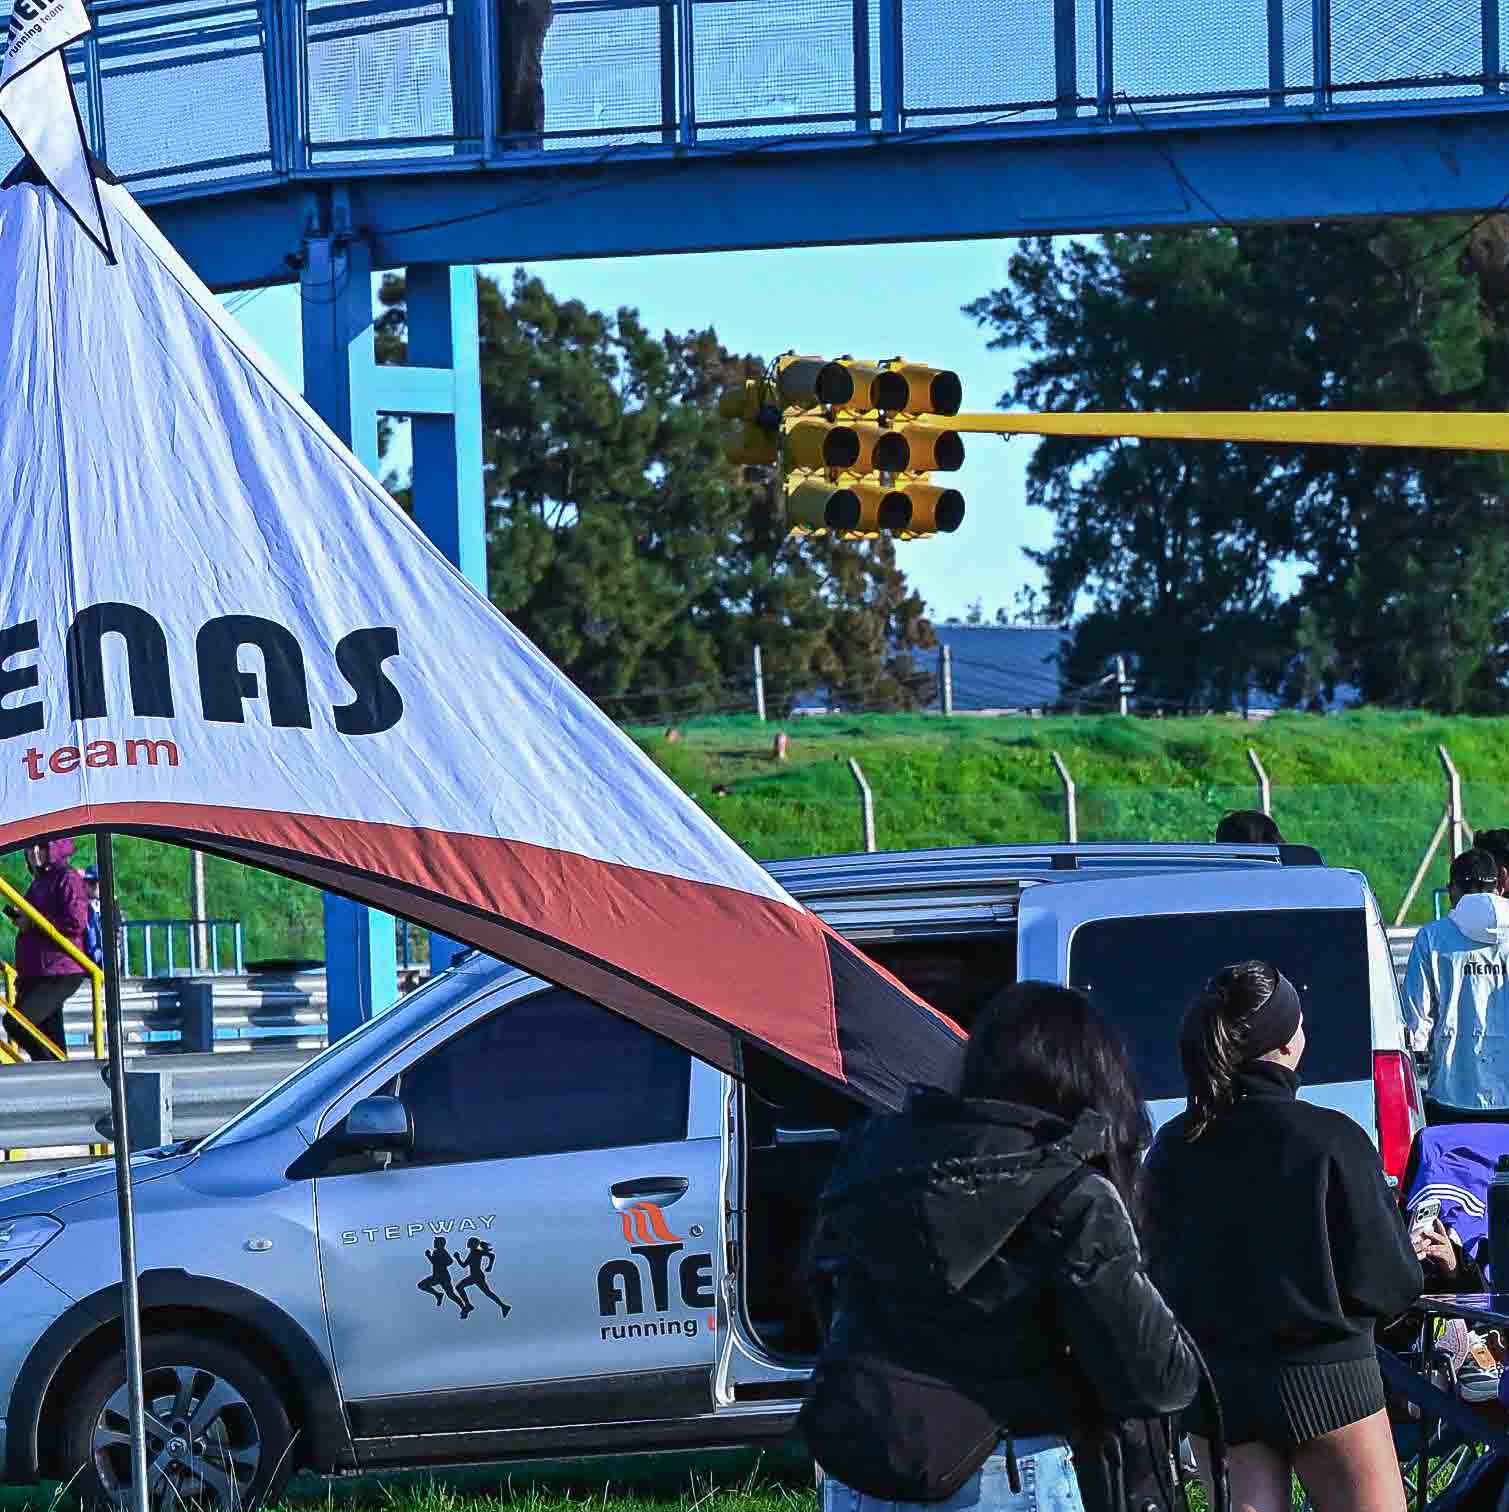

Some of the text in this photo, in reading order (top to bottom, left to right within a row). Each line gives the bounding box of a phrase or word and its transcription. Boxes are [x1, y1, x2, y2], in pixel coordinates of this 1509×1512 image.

[8, 23, 42, 57] running
[40, 4, 64, 24] team
[22, 738, 180, 781] team
[341, 1214, 498, 1245] STEPWAY
[600, 1315, 700, 1342] running
